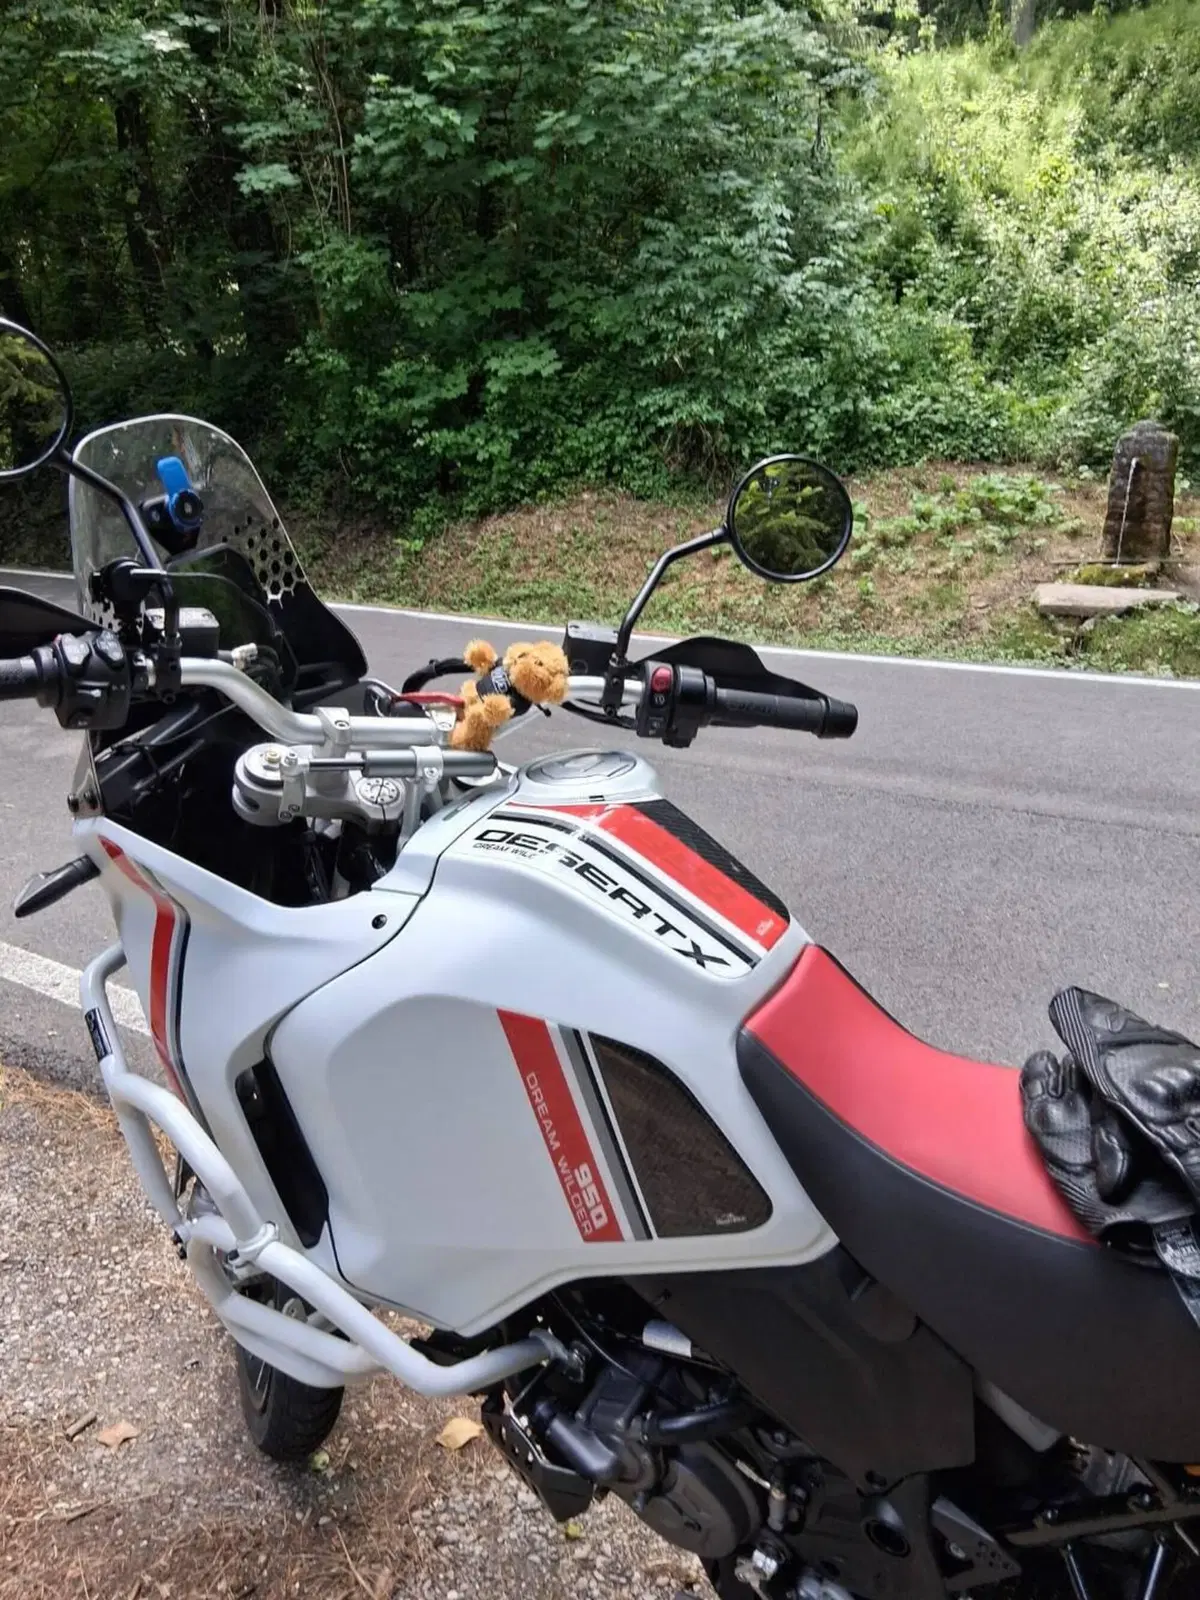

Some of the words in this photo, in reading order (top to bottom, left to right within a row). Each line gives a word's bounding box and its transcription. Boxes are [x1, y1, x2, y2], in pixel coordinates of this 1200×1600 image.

[472, 842, 510, 852] DREAM
[474, 829, 731, 969] DESERTX
[526, 1072, 560, 1151] DREAM
[558, 1155, 593, 1236] WILDER
[574, 1163, 608, 1230] 950
